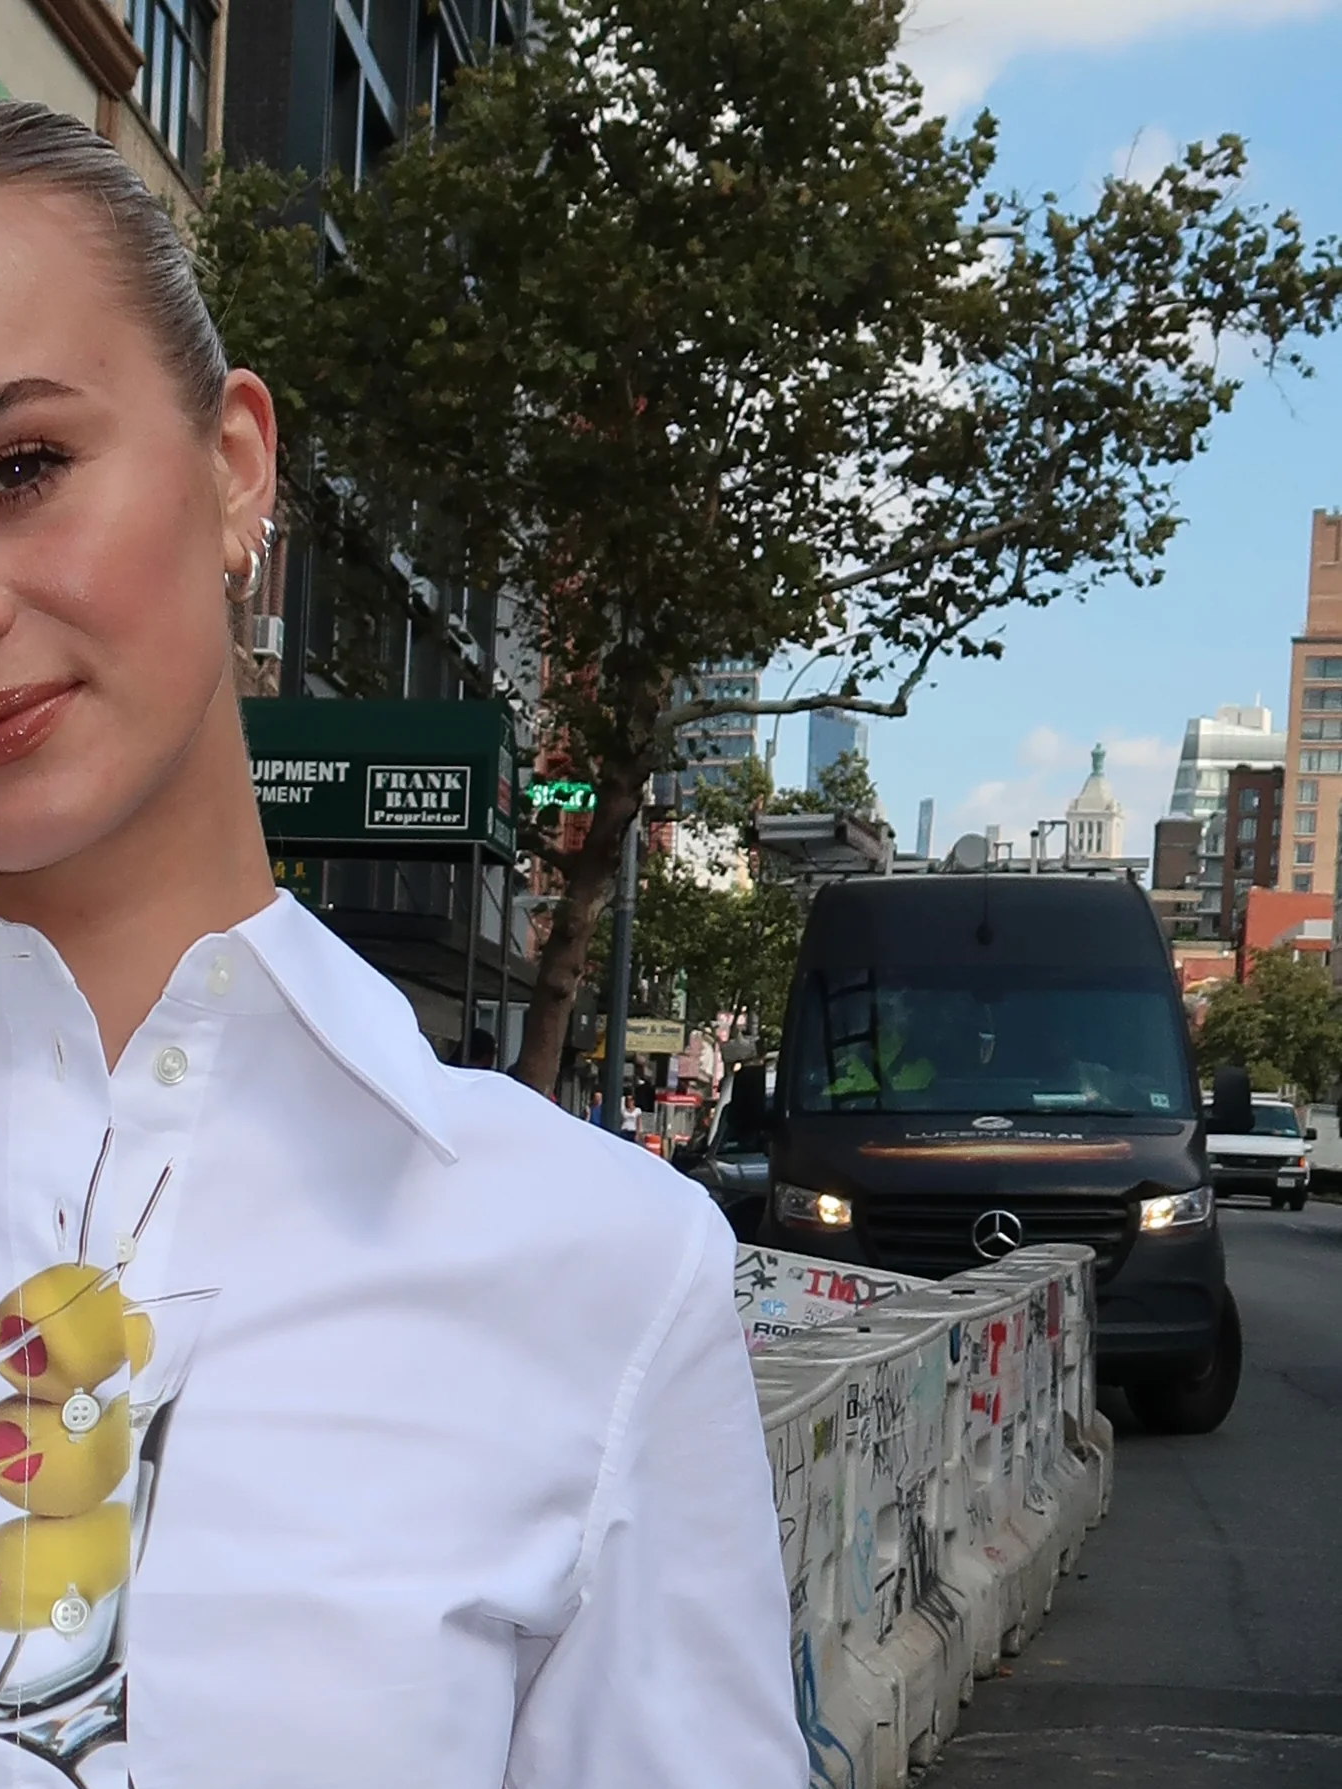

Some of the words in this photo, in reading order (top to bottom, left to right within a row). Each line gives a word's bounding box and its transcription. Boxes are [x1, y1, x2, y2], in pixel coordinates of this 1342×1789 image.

[374, 772, 462, 790] FRANK
[385, 791, 450, 808] BARI
[374, 810, 461, 826] Proprietor
